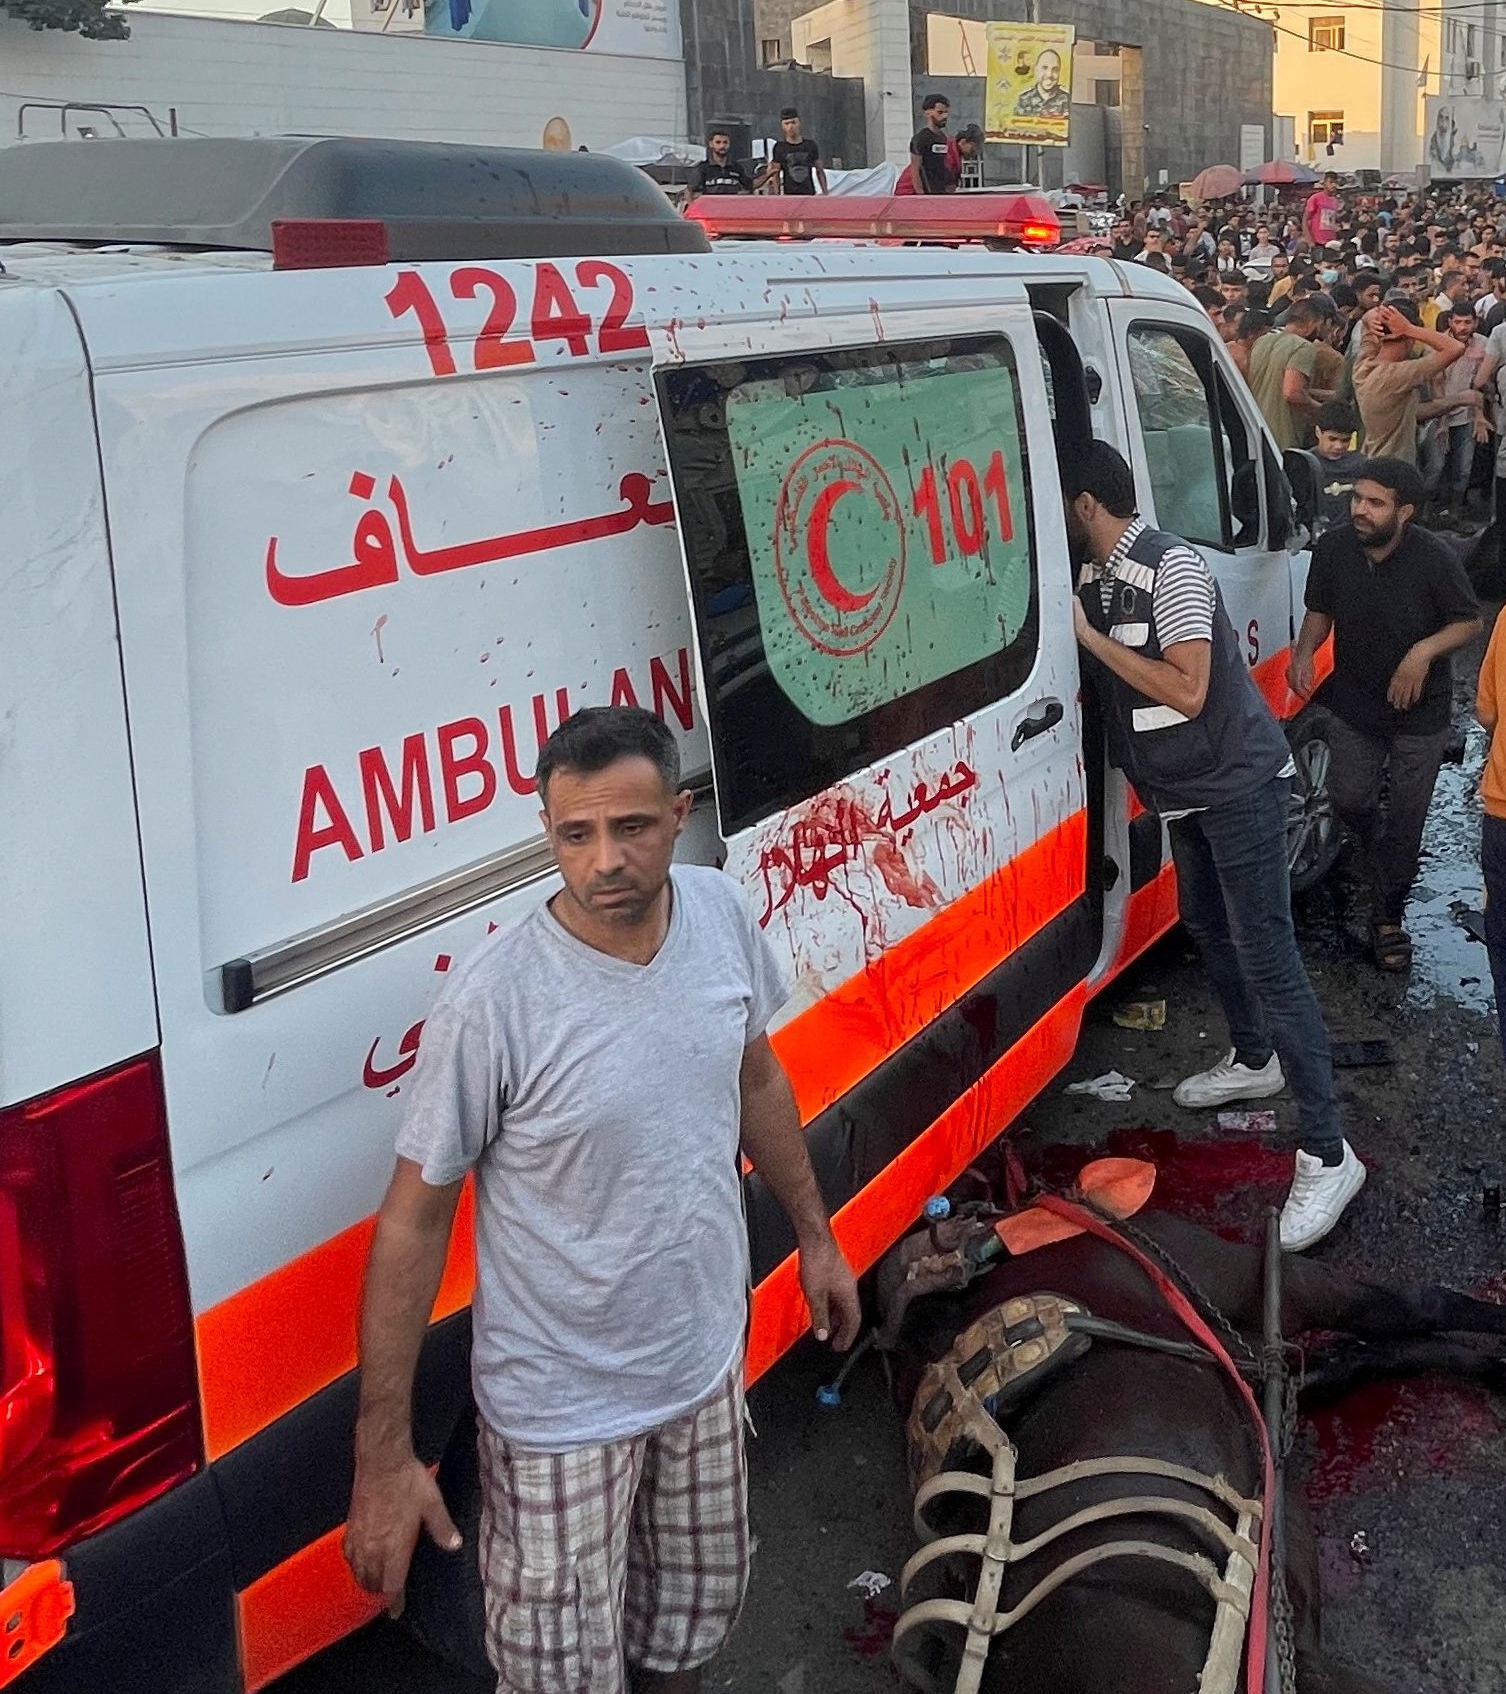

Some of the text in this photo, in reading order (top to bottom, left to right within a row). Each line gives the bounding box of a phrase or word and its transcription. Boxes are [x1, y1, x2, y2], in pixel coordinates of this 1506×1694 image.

[384, 261, 651, 375] 1242
[266, 471, 677, 606] عاف
[913, 450, 1013, 565] 101
[875, 760, 978, 847] جمعية
